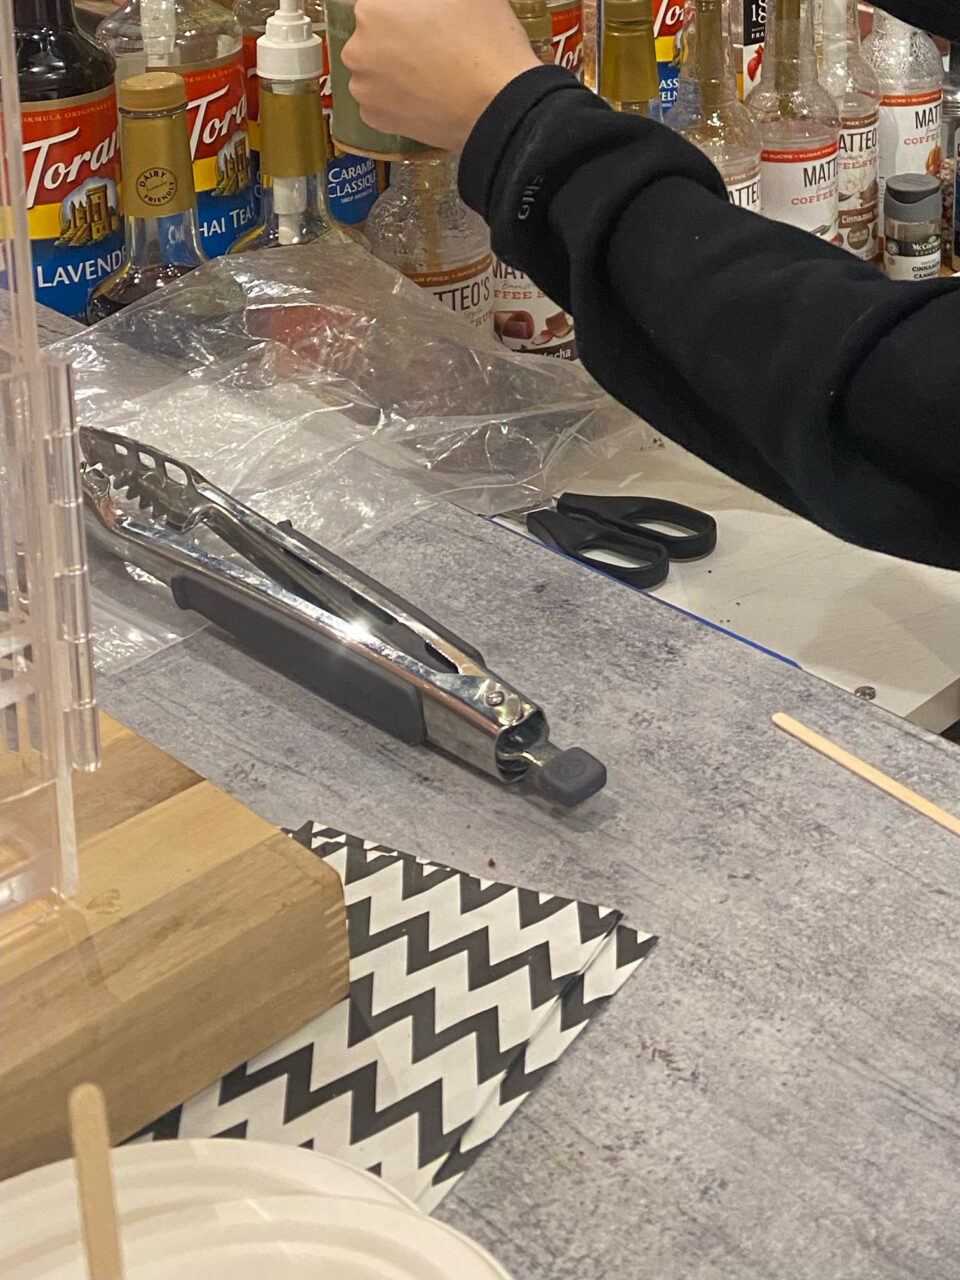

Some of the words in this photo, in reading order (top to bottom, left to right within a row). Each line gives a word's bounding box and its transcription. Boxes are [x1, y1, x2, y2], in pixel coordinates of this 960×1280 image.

[139, 171, 167, 188] DAIRY
[144, 181, 175, 203] FRIENDLY
[229, 206, 251, 228] TEA
